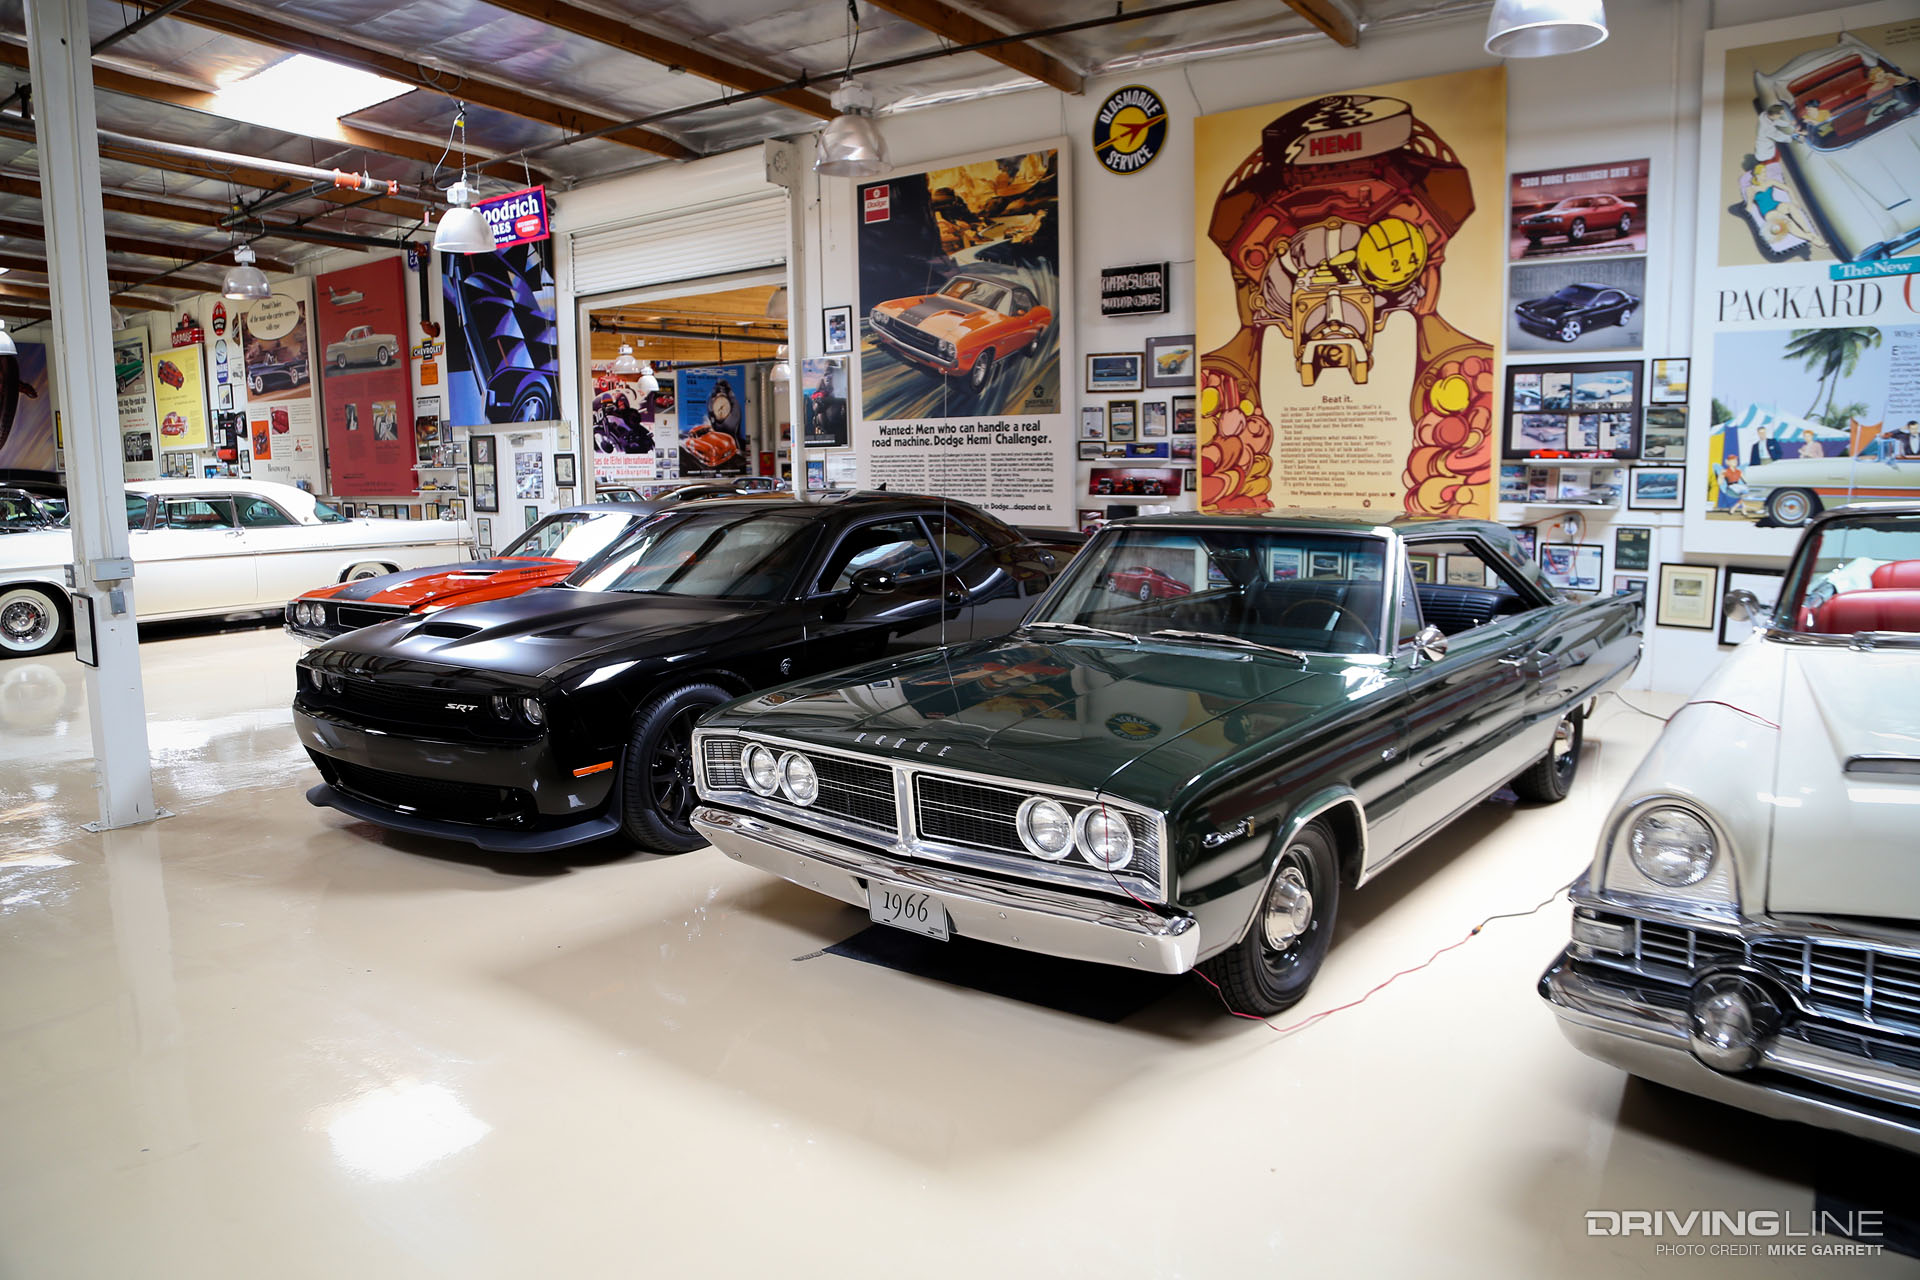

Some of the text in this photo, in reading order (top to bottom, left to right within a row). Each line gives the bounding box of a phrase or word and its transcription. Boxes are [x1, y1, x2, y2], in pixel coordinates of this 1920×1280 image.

[1100, 90, 1160, 124] OLDSMOBILE
[1309, 132, 1362, 156] HEMI
[1106, 144, 1153, 170] SERVICE
[866, 200, 888, 210] Dodge
[490, 221, 512, 236] RES
[409, 256, 419, 266] CA
[1391, 252, 1419, 273] 2 4
[1838, 261, 1913, 278] The New
[1102, 272, 1161, 292] CHRYSLER
[1103, 293, 1160, 310] MOTOR CARS
[1717, 282, 1882, 322] PACKARD
[413, 345, 442, 357] CHEVROLET
[1322, 394, 1353, 404] Beat it.
[879, 420, 1040, 436] Wanted: Men who can handle a real
[872, 433, 1052, 447] road machine. Dodge Hemi Challenger.
[444, 702, 479, 713] SRT
[854, 732, 952, 757] DODGE
[882, 890, 930, 923] 1966
